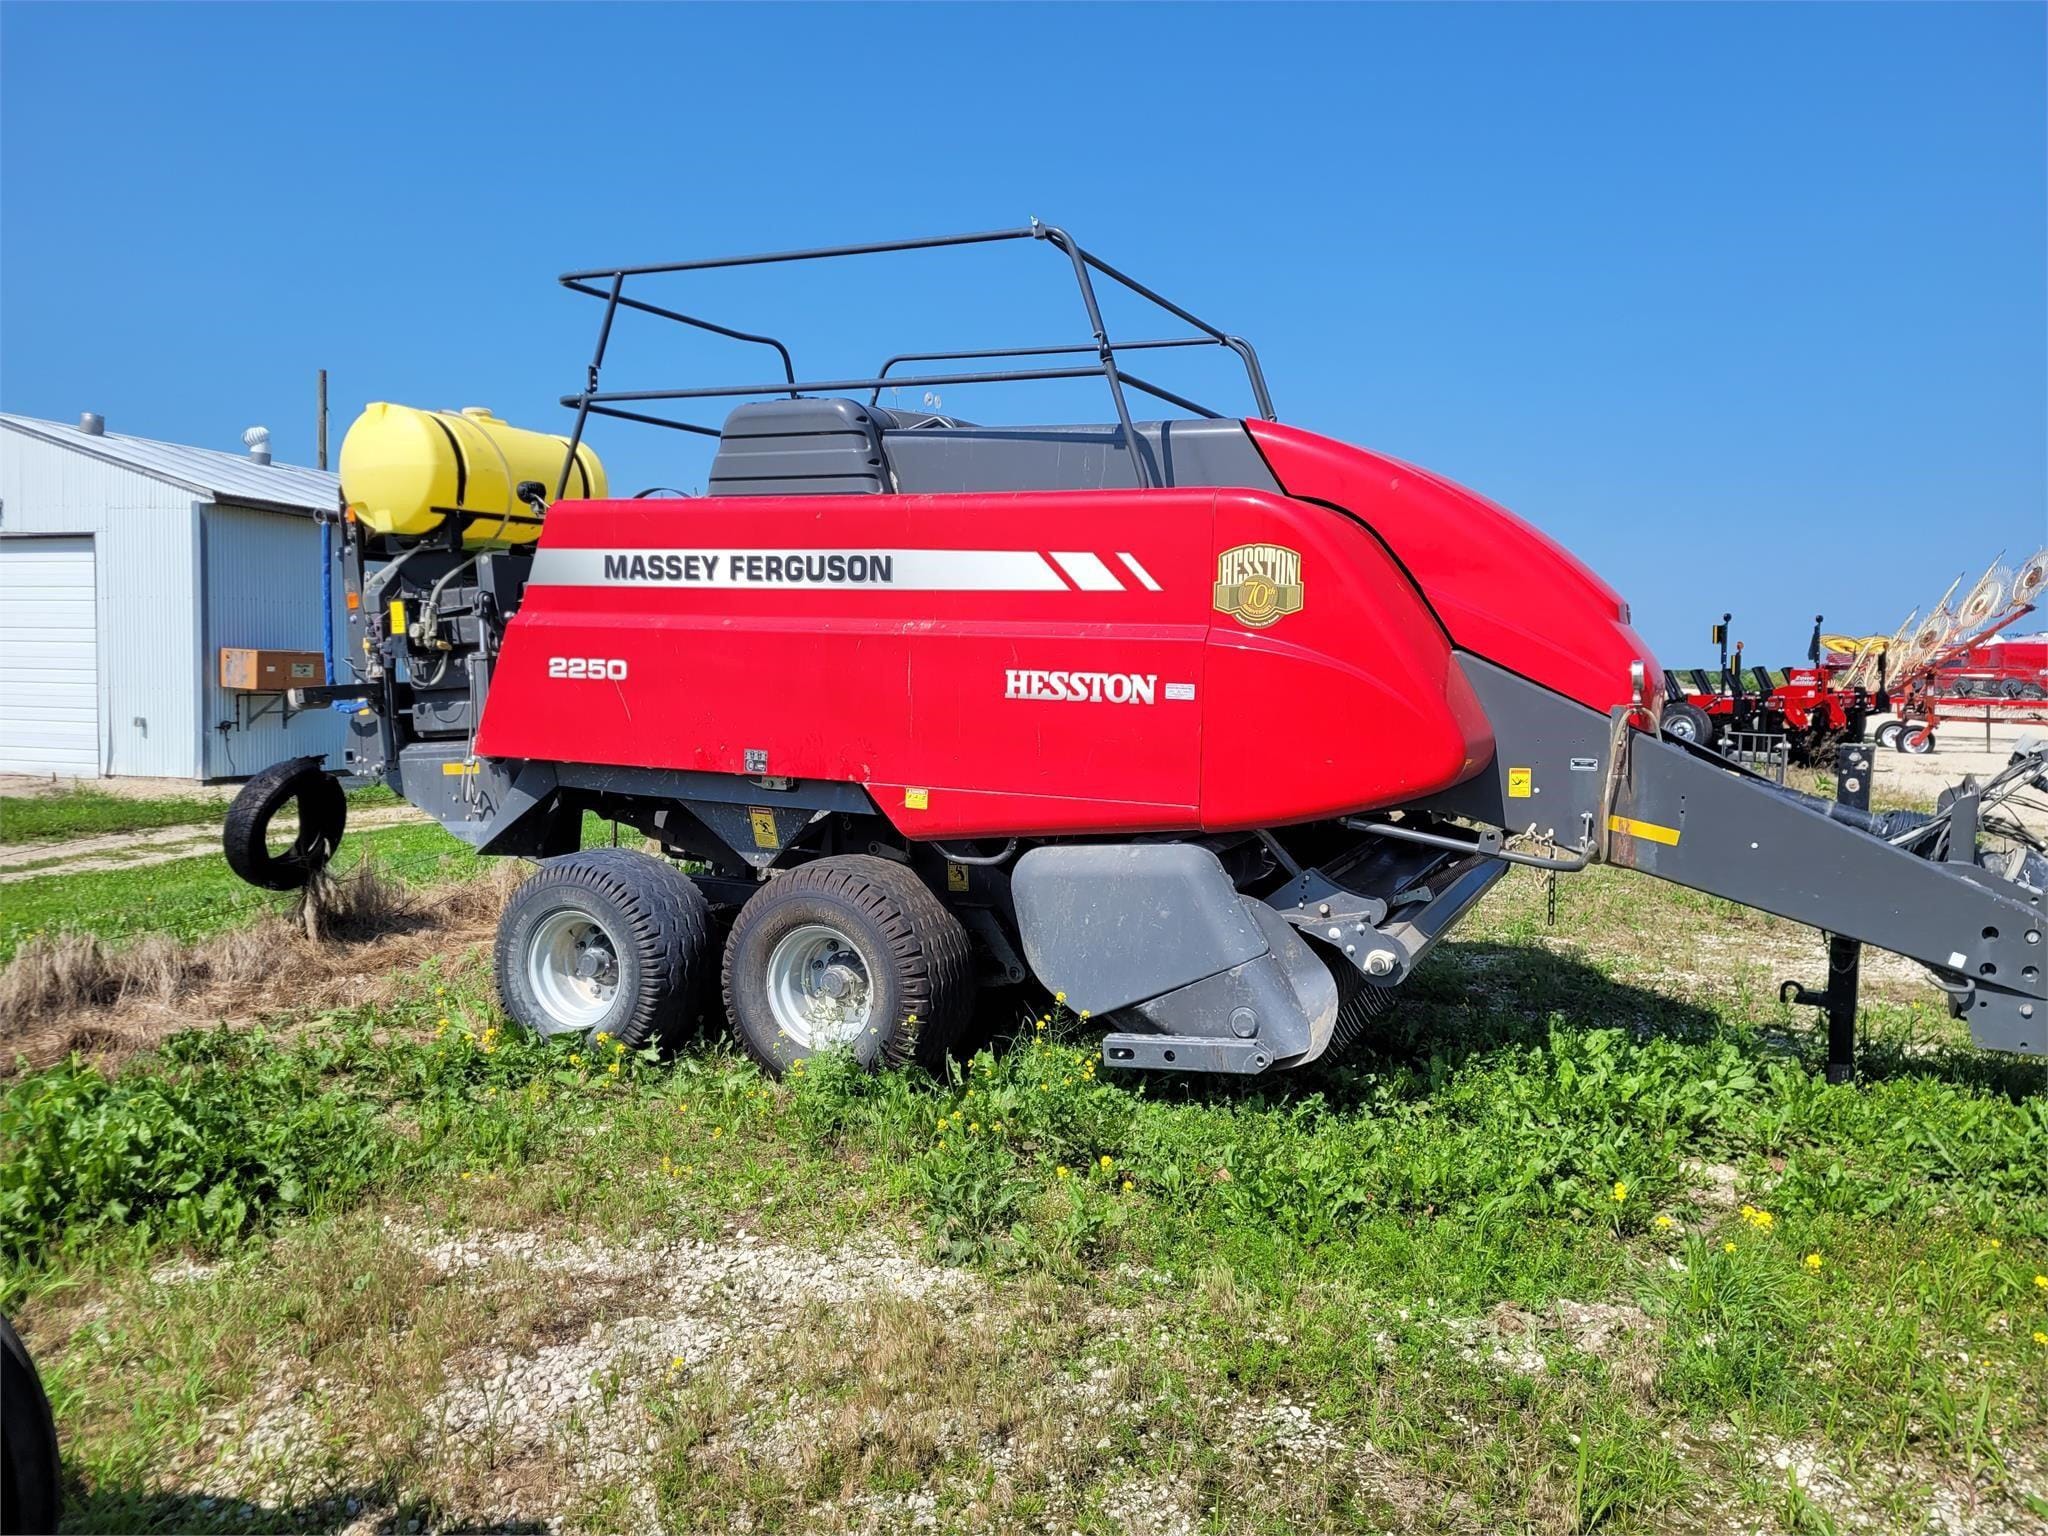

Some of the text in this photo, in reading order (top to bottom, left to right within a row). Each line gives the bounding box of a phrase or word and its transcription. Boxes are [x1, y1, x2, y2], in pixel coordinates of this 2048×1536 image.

[604, 554, 894, 583] MASSEY FERGUSON
[1221, 546, 1298, 586] HESSTON
[1244, 581, 1276, 608] 70th
[548, 656, 628, 681] 2250
[1004, 669, 1158, 705] HESSTON
